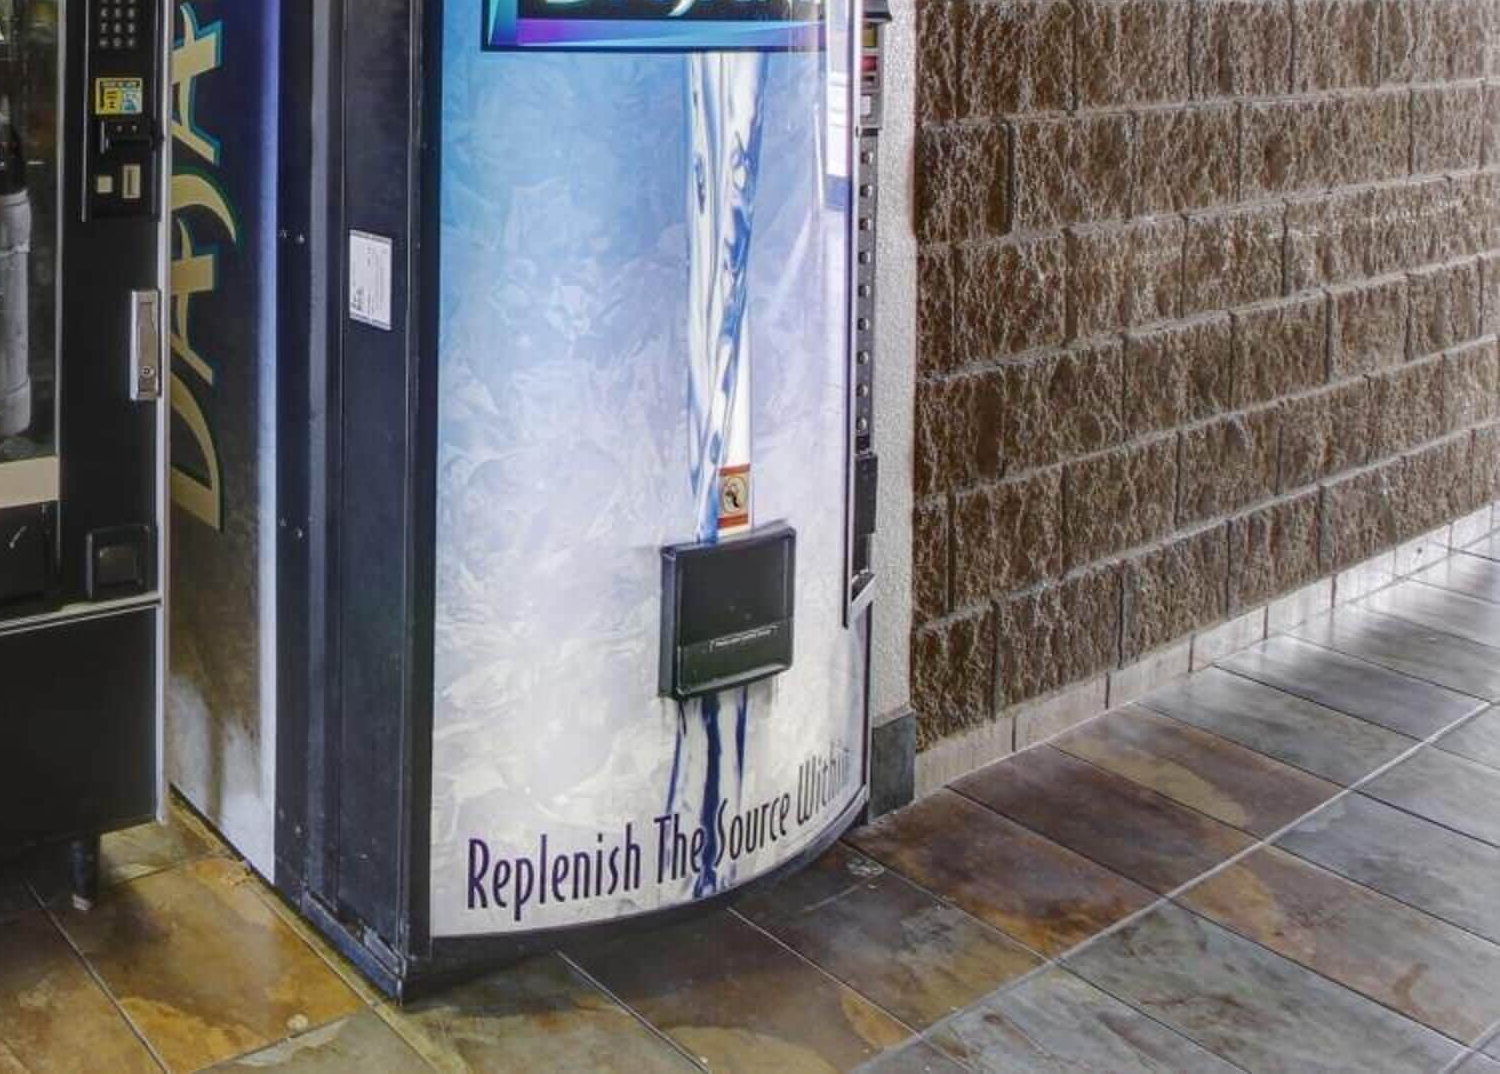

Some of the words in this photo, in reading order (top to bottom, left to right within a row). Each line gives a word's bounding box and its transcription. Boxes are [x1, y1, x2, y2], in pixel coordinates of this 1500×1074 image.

[467, 823, 641, 922] Replenish
[654, 813, 702, 884] The
[715, 798, 790, 866] Source
